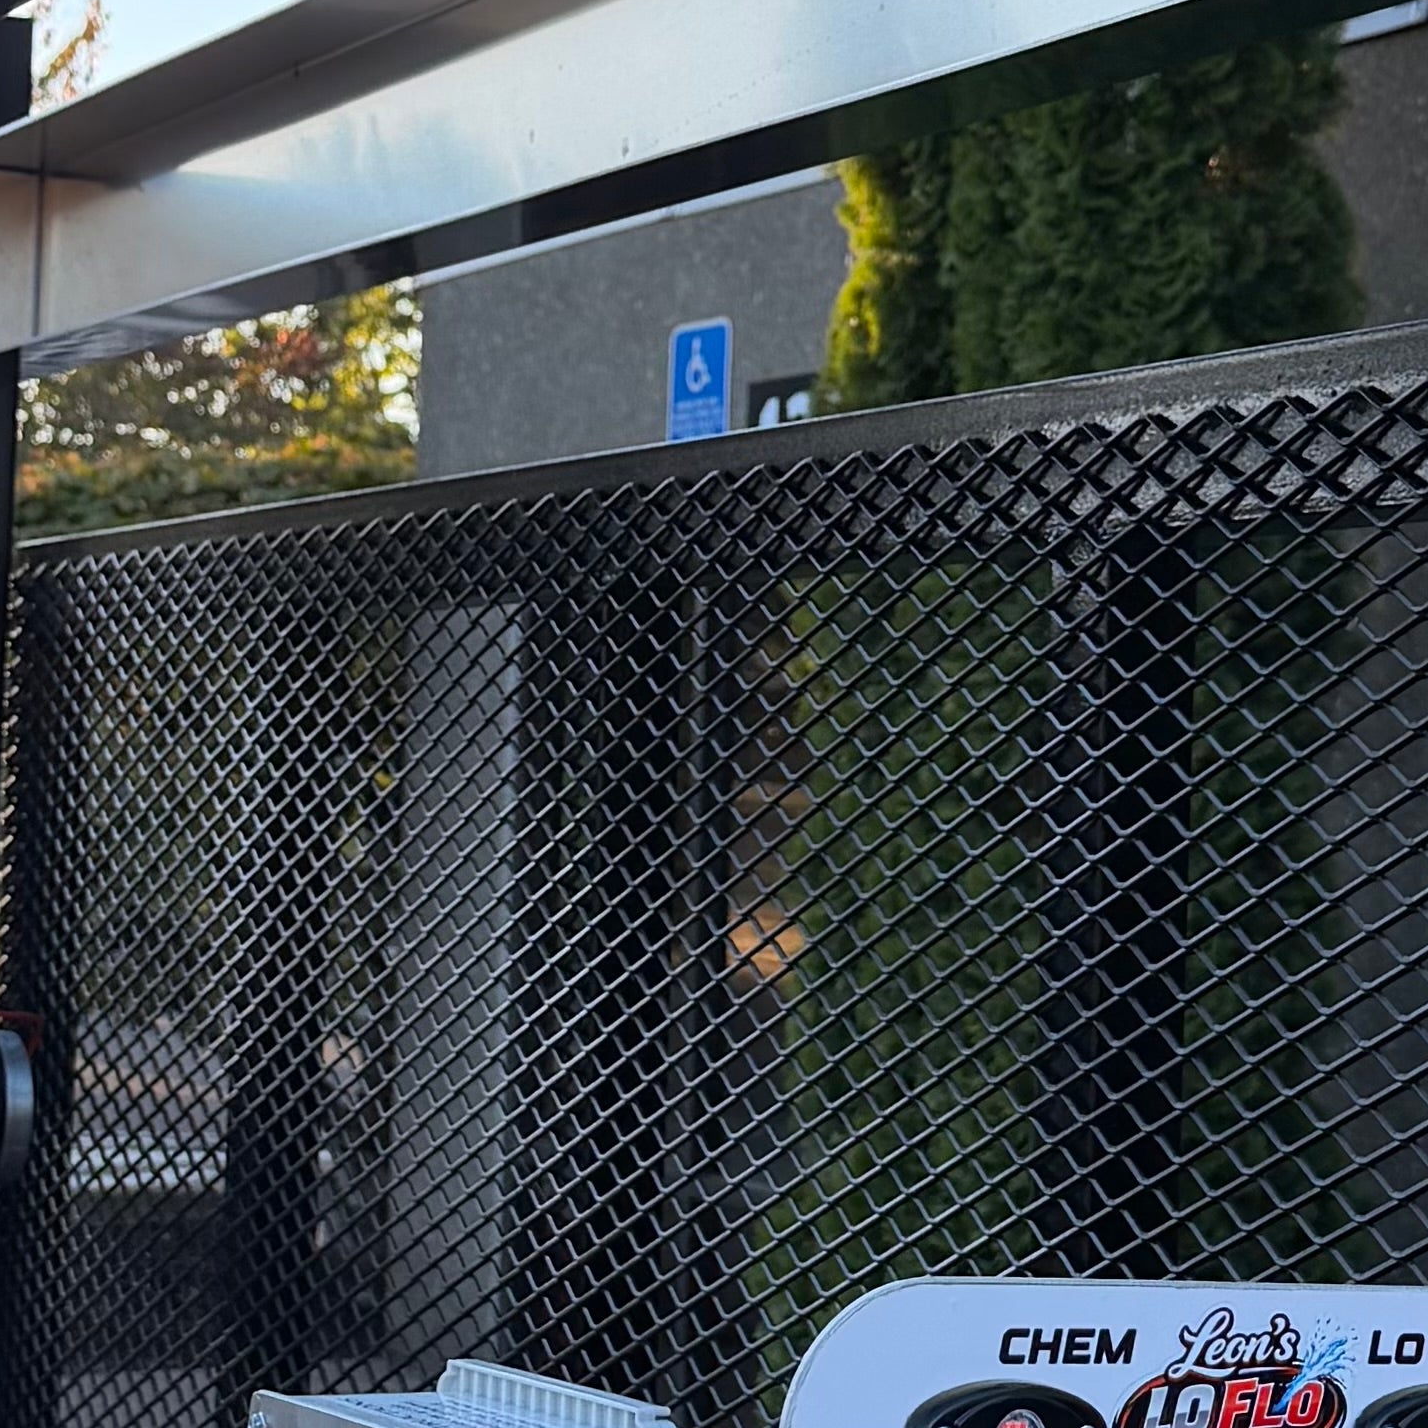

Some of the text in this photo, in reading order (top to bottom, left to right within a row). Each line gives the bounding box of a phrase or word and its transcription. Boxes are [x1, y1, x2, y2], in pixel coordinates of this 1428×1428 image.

[999, 1328, 1137, 1365] CHEM
[1167, 1308, 1300, 1378] Leon's
[1368, 1330, 1425, 1365] LO
